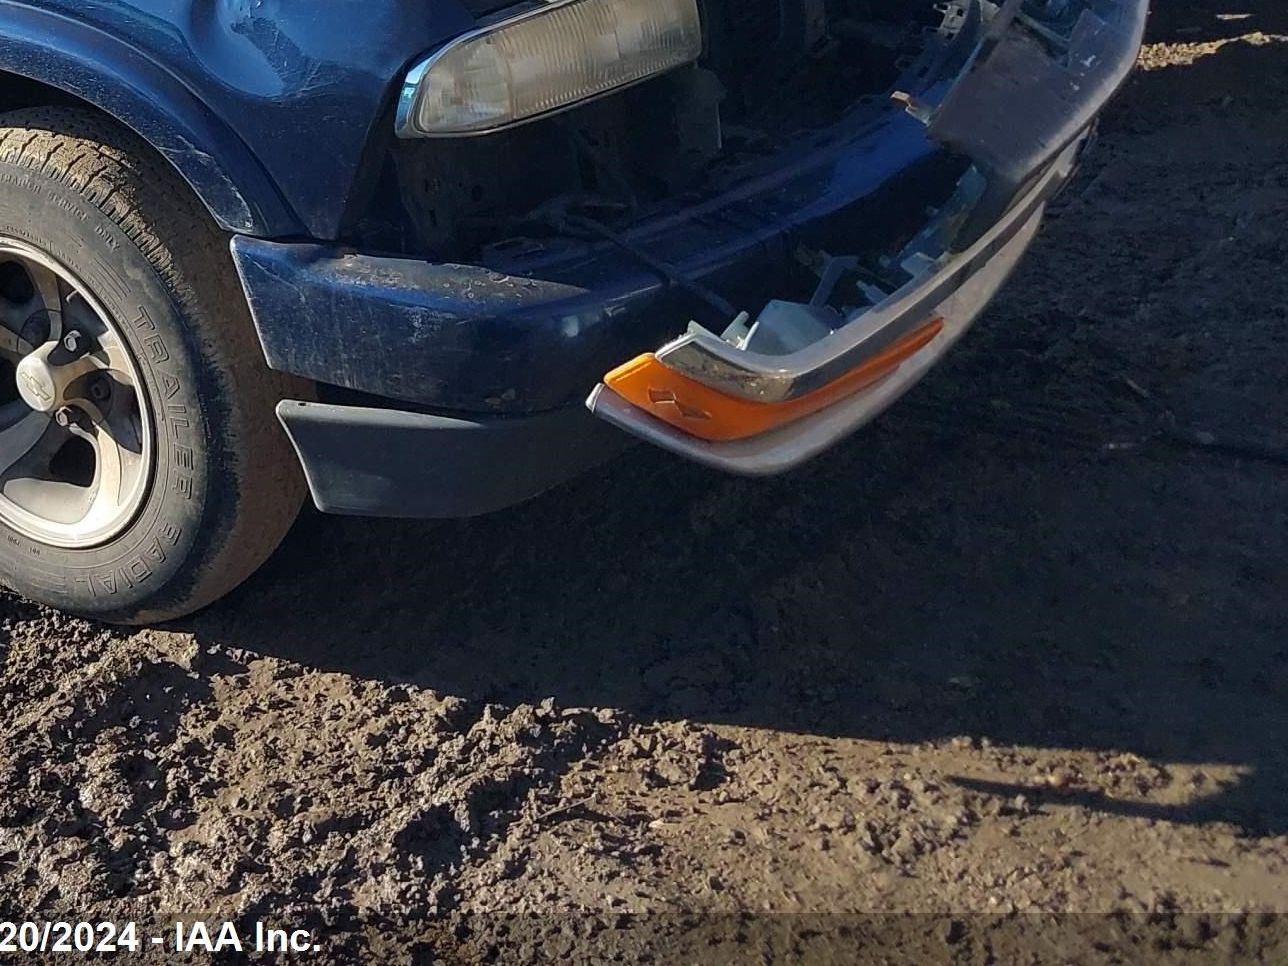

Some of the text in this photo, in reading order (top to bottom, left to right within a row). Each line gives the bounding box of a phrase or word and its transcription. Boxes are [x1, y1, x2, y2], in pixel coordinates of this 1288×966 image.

[93, 224, 121, 251] ONLY
[75, 305, 195, 598] TRAILER RADIAL
